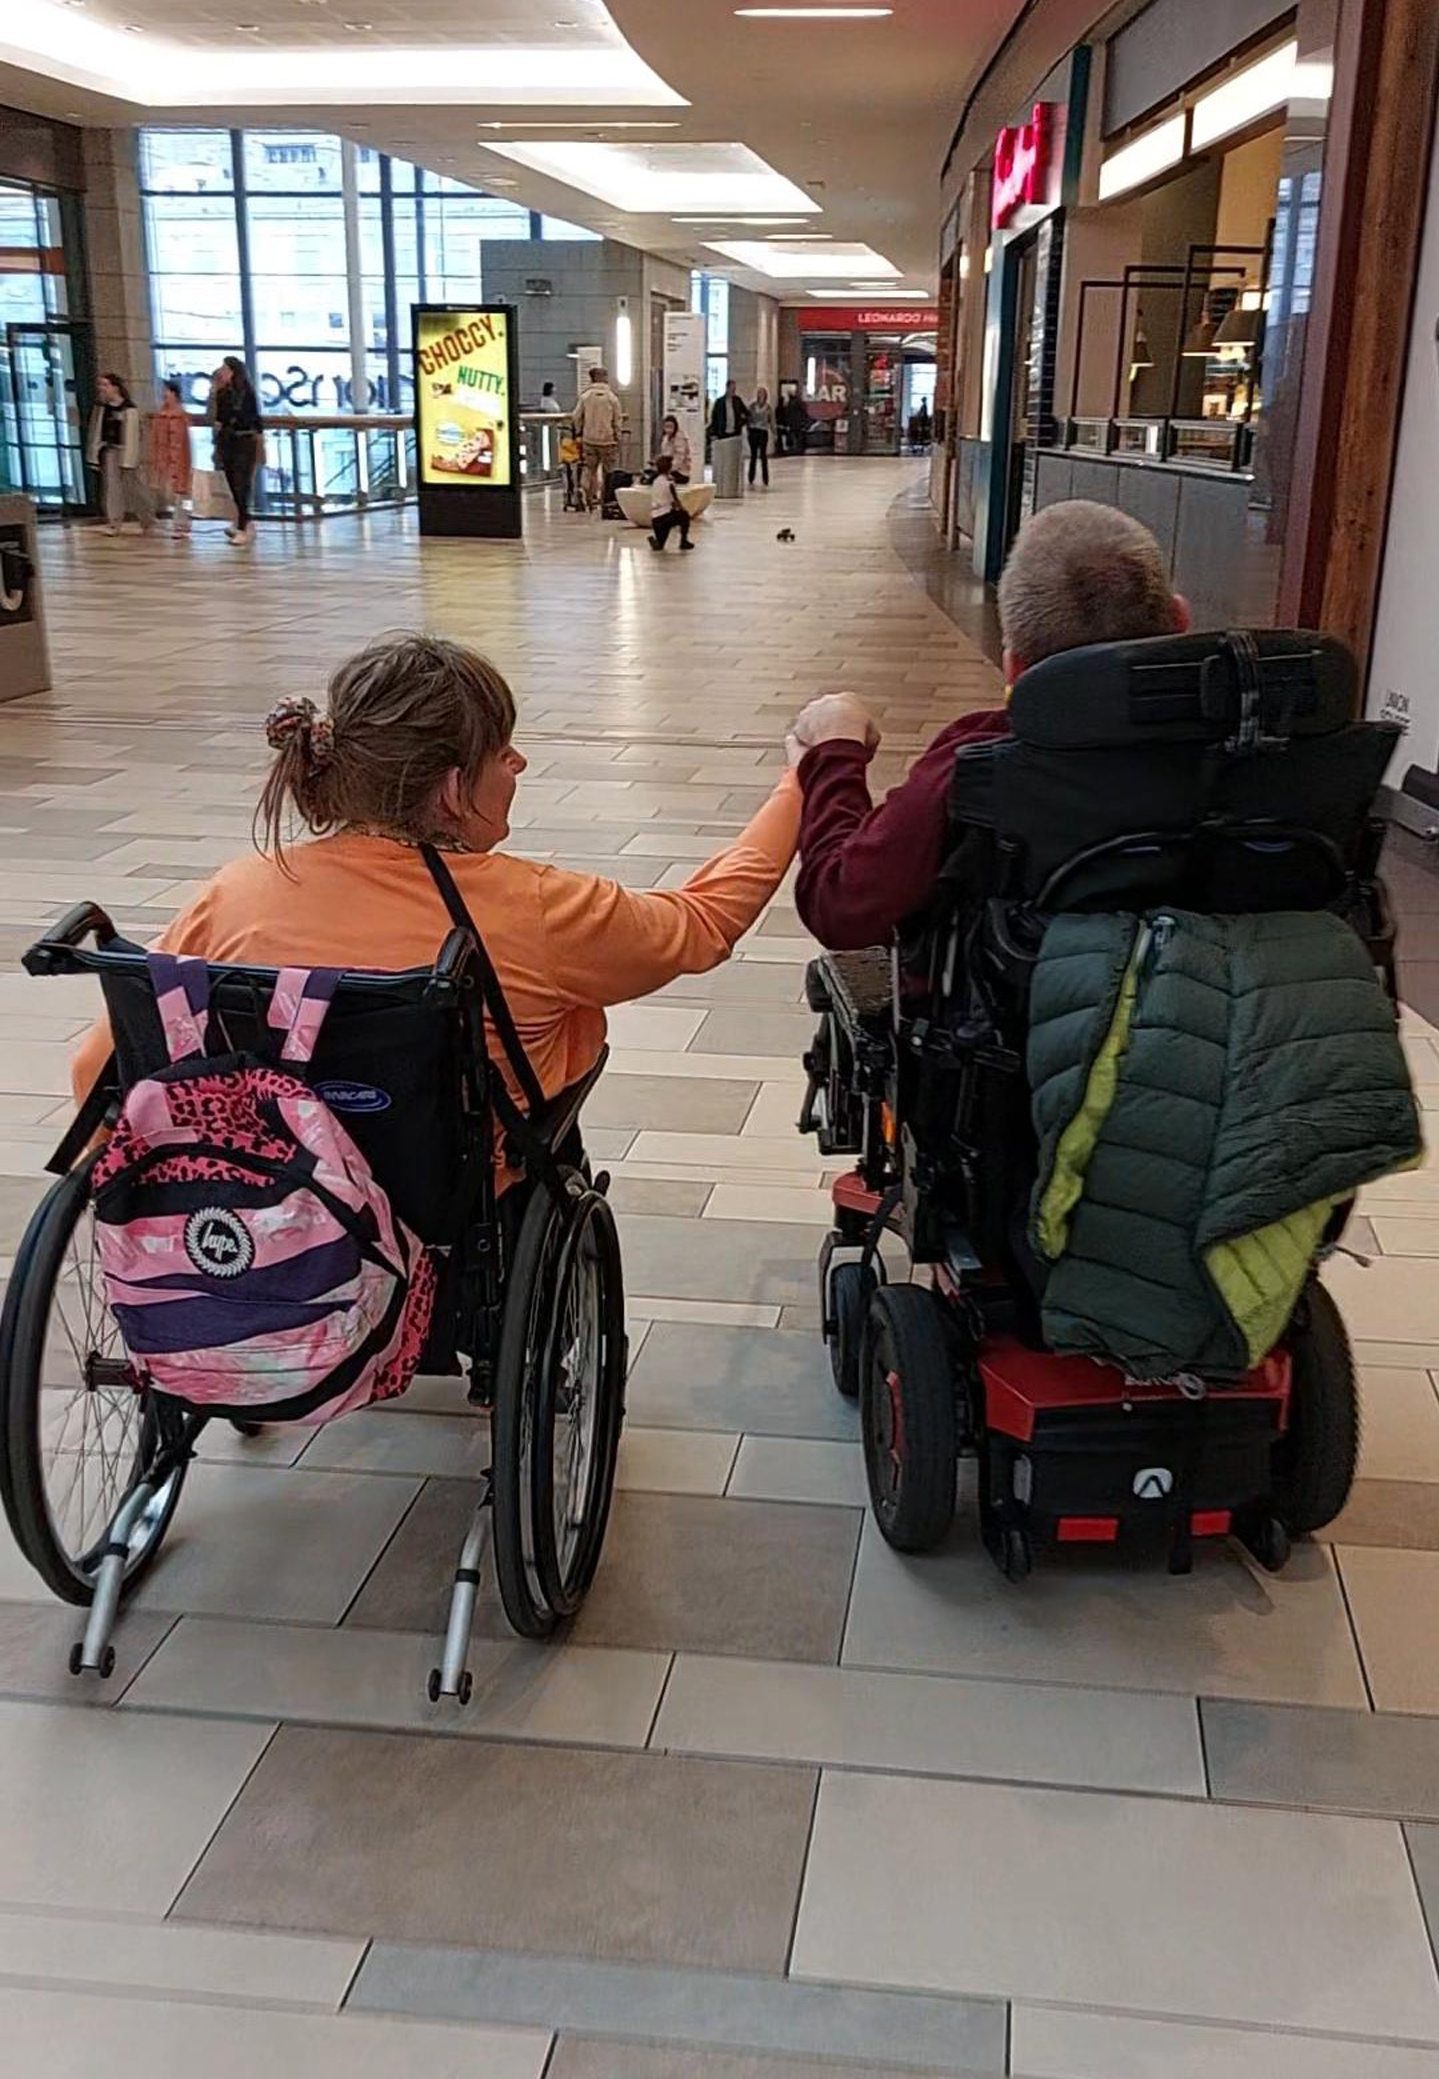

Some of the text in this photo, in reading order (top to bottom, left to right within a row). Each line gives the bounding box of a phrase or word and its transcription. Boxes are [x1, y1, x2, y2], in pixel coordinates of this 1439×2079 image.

[858, 313, 920, 323] LEONARDO
[419, 315, 504, 376] CHOCCY.
[457, 365, 505, 396] NUTTY.
